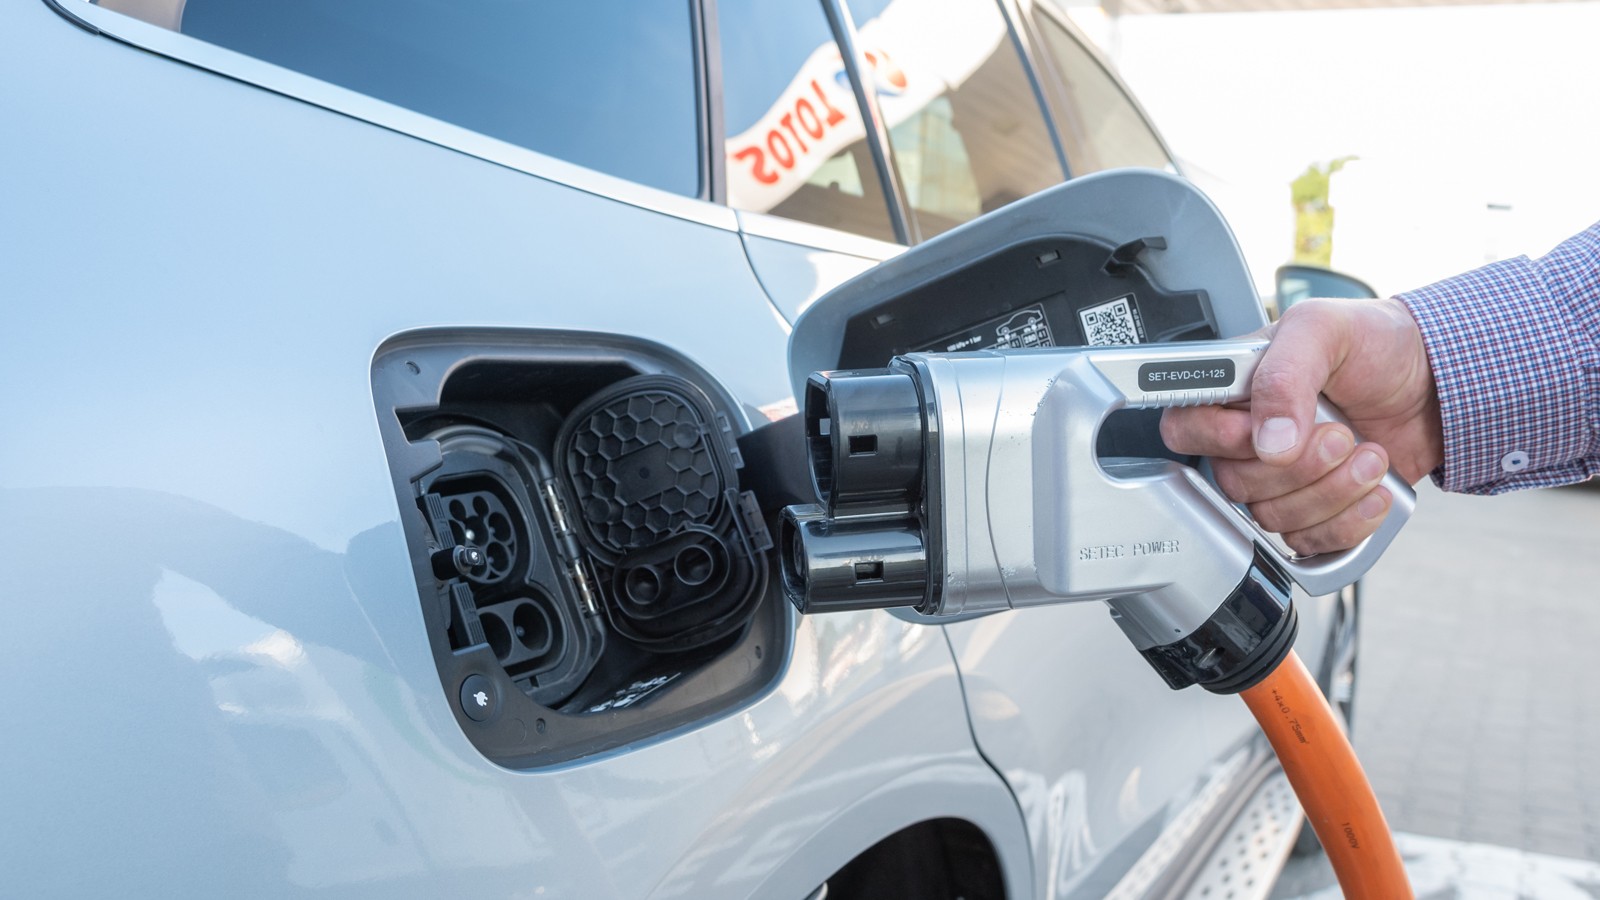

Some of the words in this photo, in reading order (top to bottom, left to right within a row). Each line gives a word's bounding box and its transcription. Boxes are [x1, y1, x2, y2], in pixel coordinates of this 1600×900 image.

[1148, 369, 1225, 381] SET-EVD-C1-125
[1079, 545, 1124, 560] SETEC
[1133, 539, 1180, 556] POWER
[1341, 822, 1360, 849] 1000V
